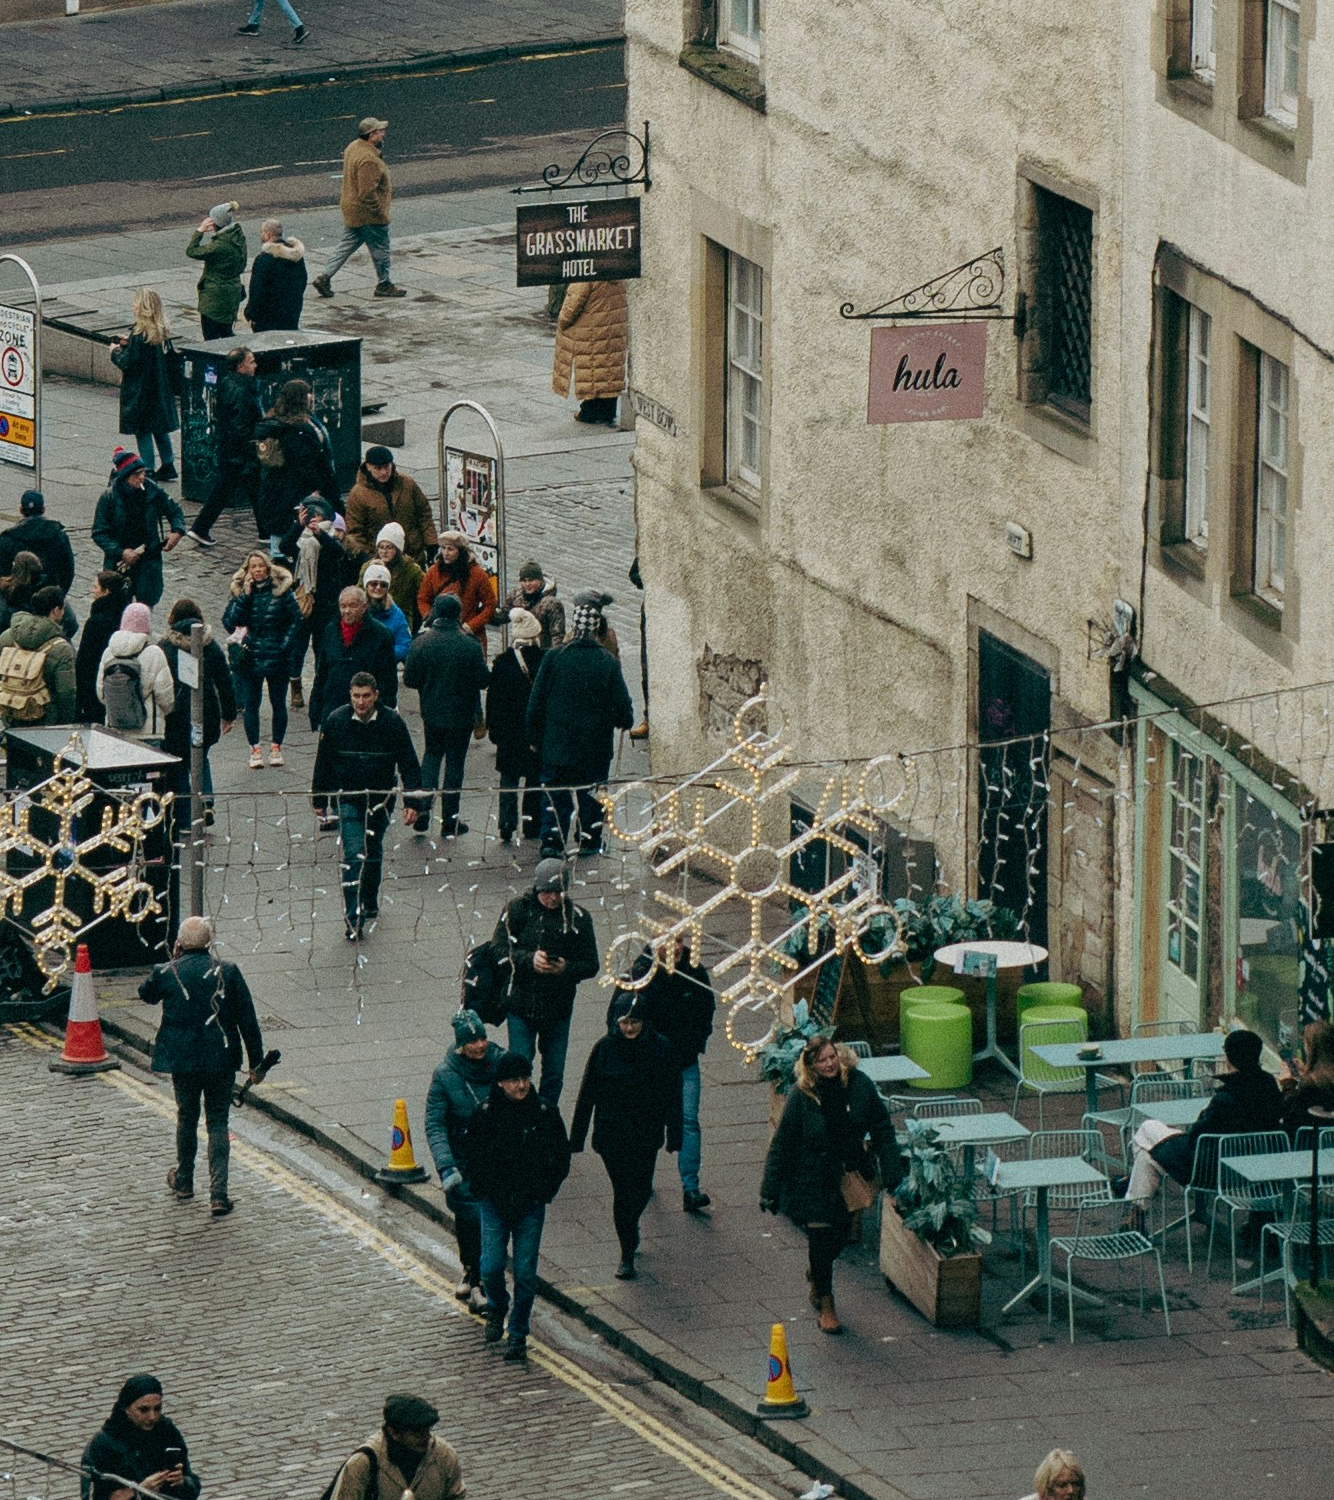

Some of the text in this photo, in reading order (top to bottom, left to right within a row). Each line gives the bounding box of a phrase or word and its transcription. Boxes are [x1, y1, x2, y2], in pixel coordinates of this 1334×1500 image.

[566, 205, 589, 224] THE
[526, 225, 635, 256] GRASSMARKET
[562, 259, 597, 278] HOTEL
[0, 329, 26, 348] ZONE
[892, 352, 963, 393] hula
